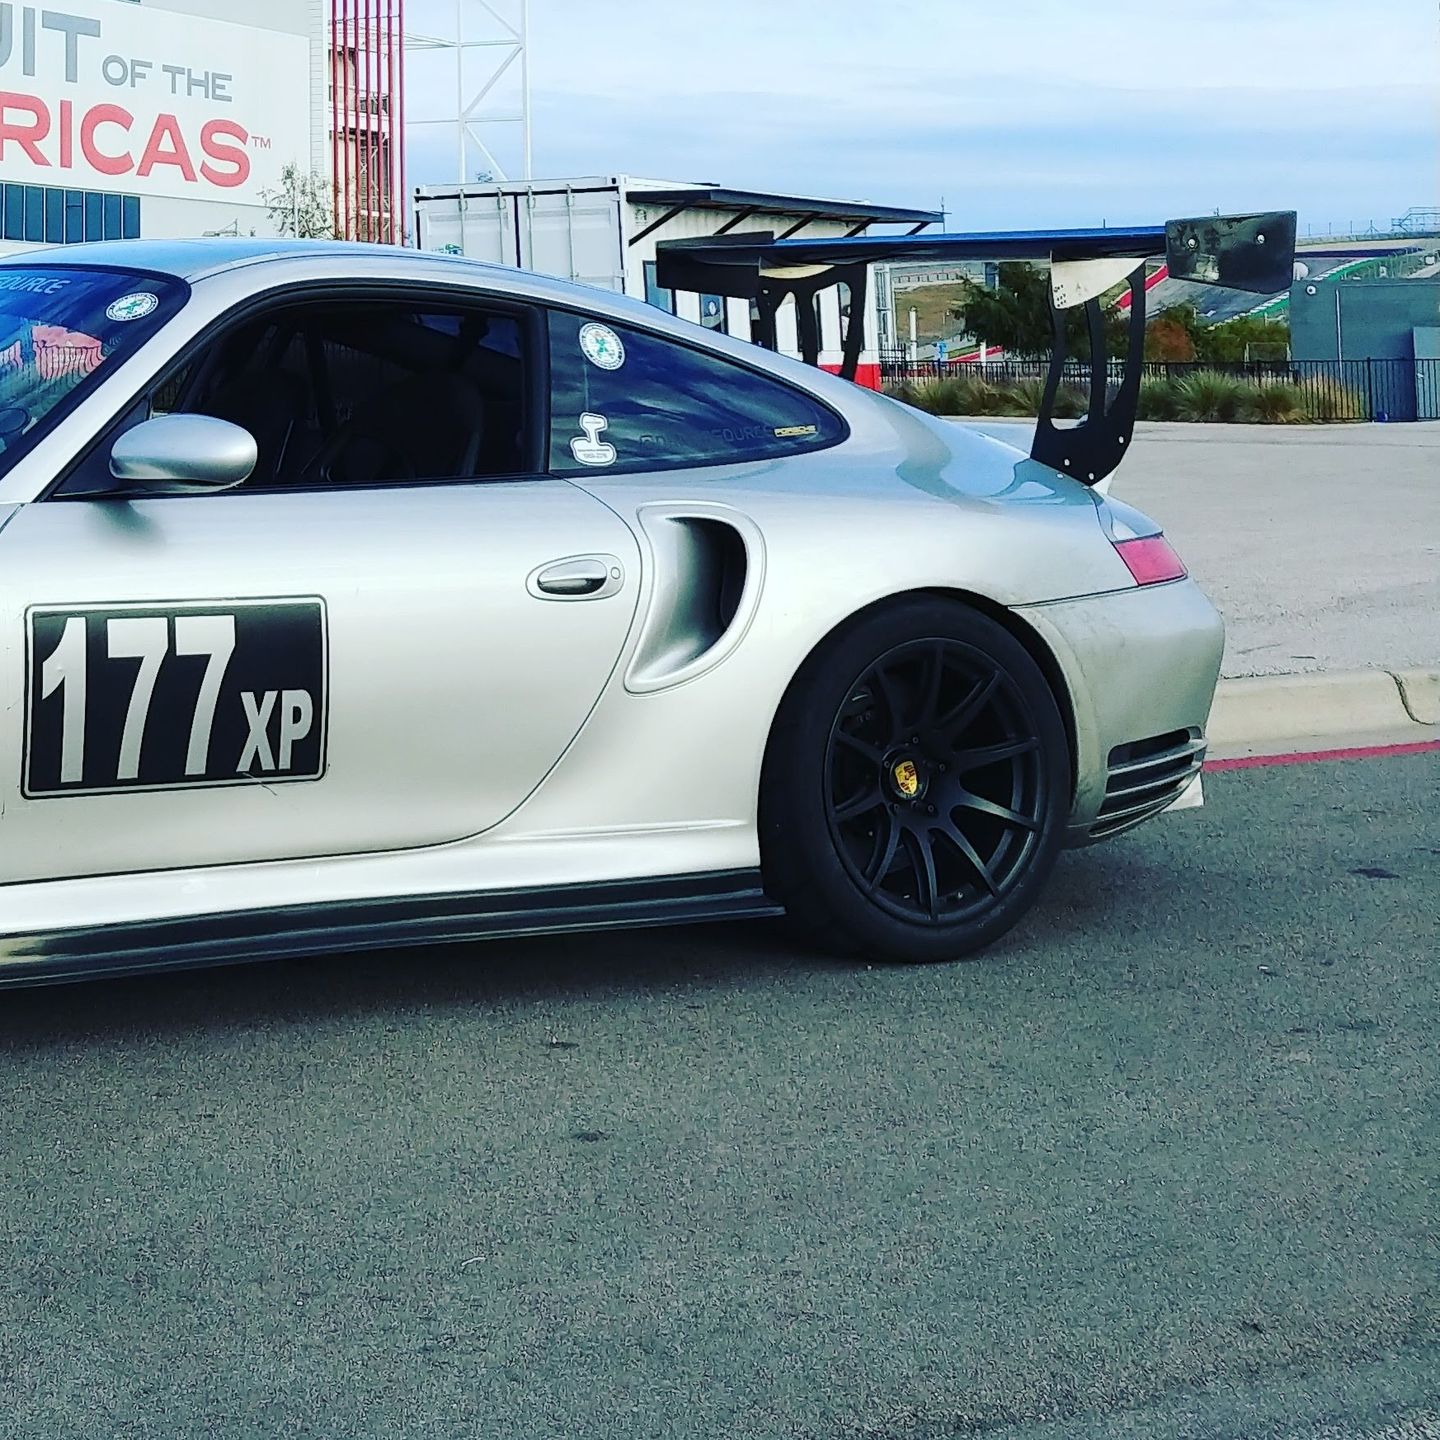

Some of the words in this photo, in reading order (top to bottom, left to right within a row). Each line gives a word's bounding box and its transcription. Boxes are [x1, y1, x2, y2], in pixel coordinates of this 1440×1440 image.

[102, 55, 153, 88] OF
[162, 64, 233, 102] THE
[42, 614, 236, 783] 177
[236, 689, 313, 772] XP
